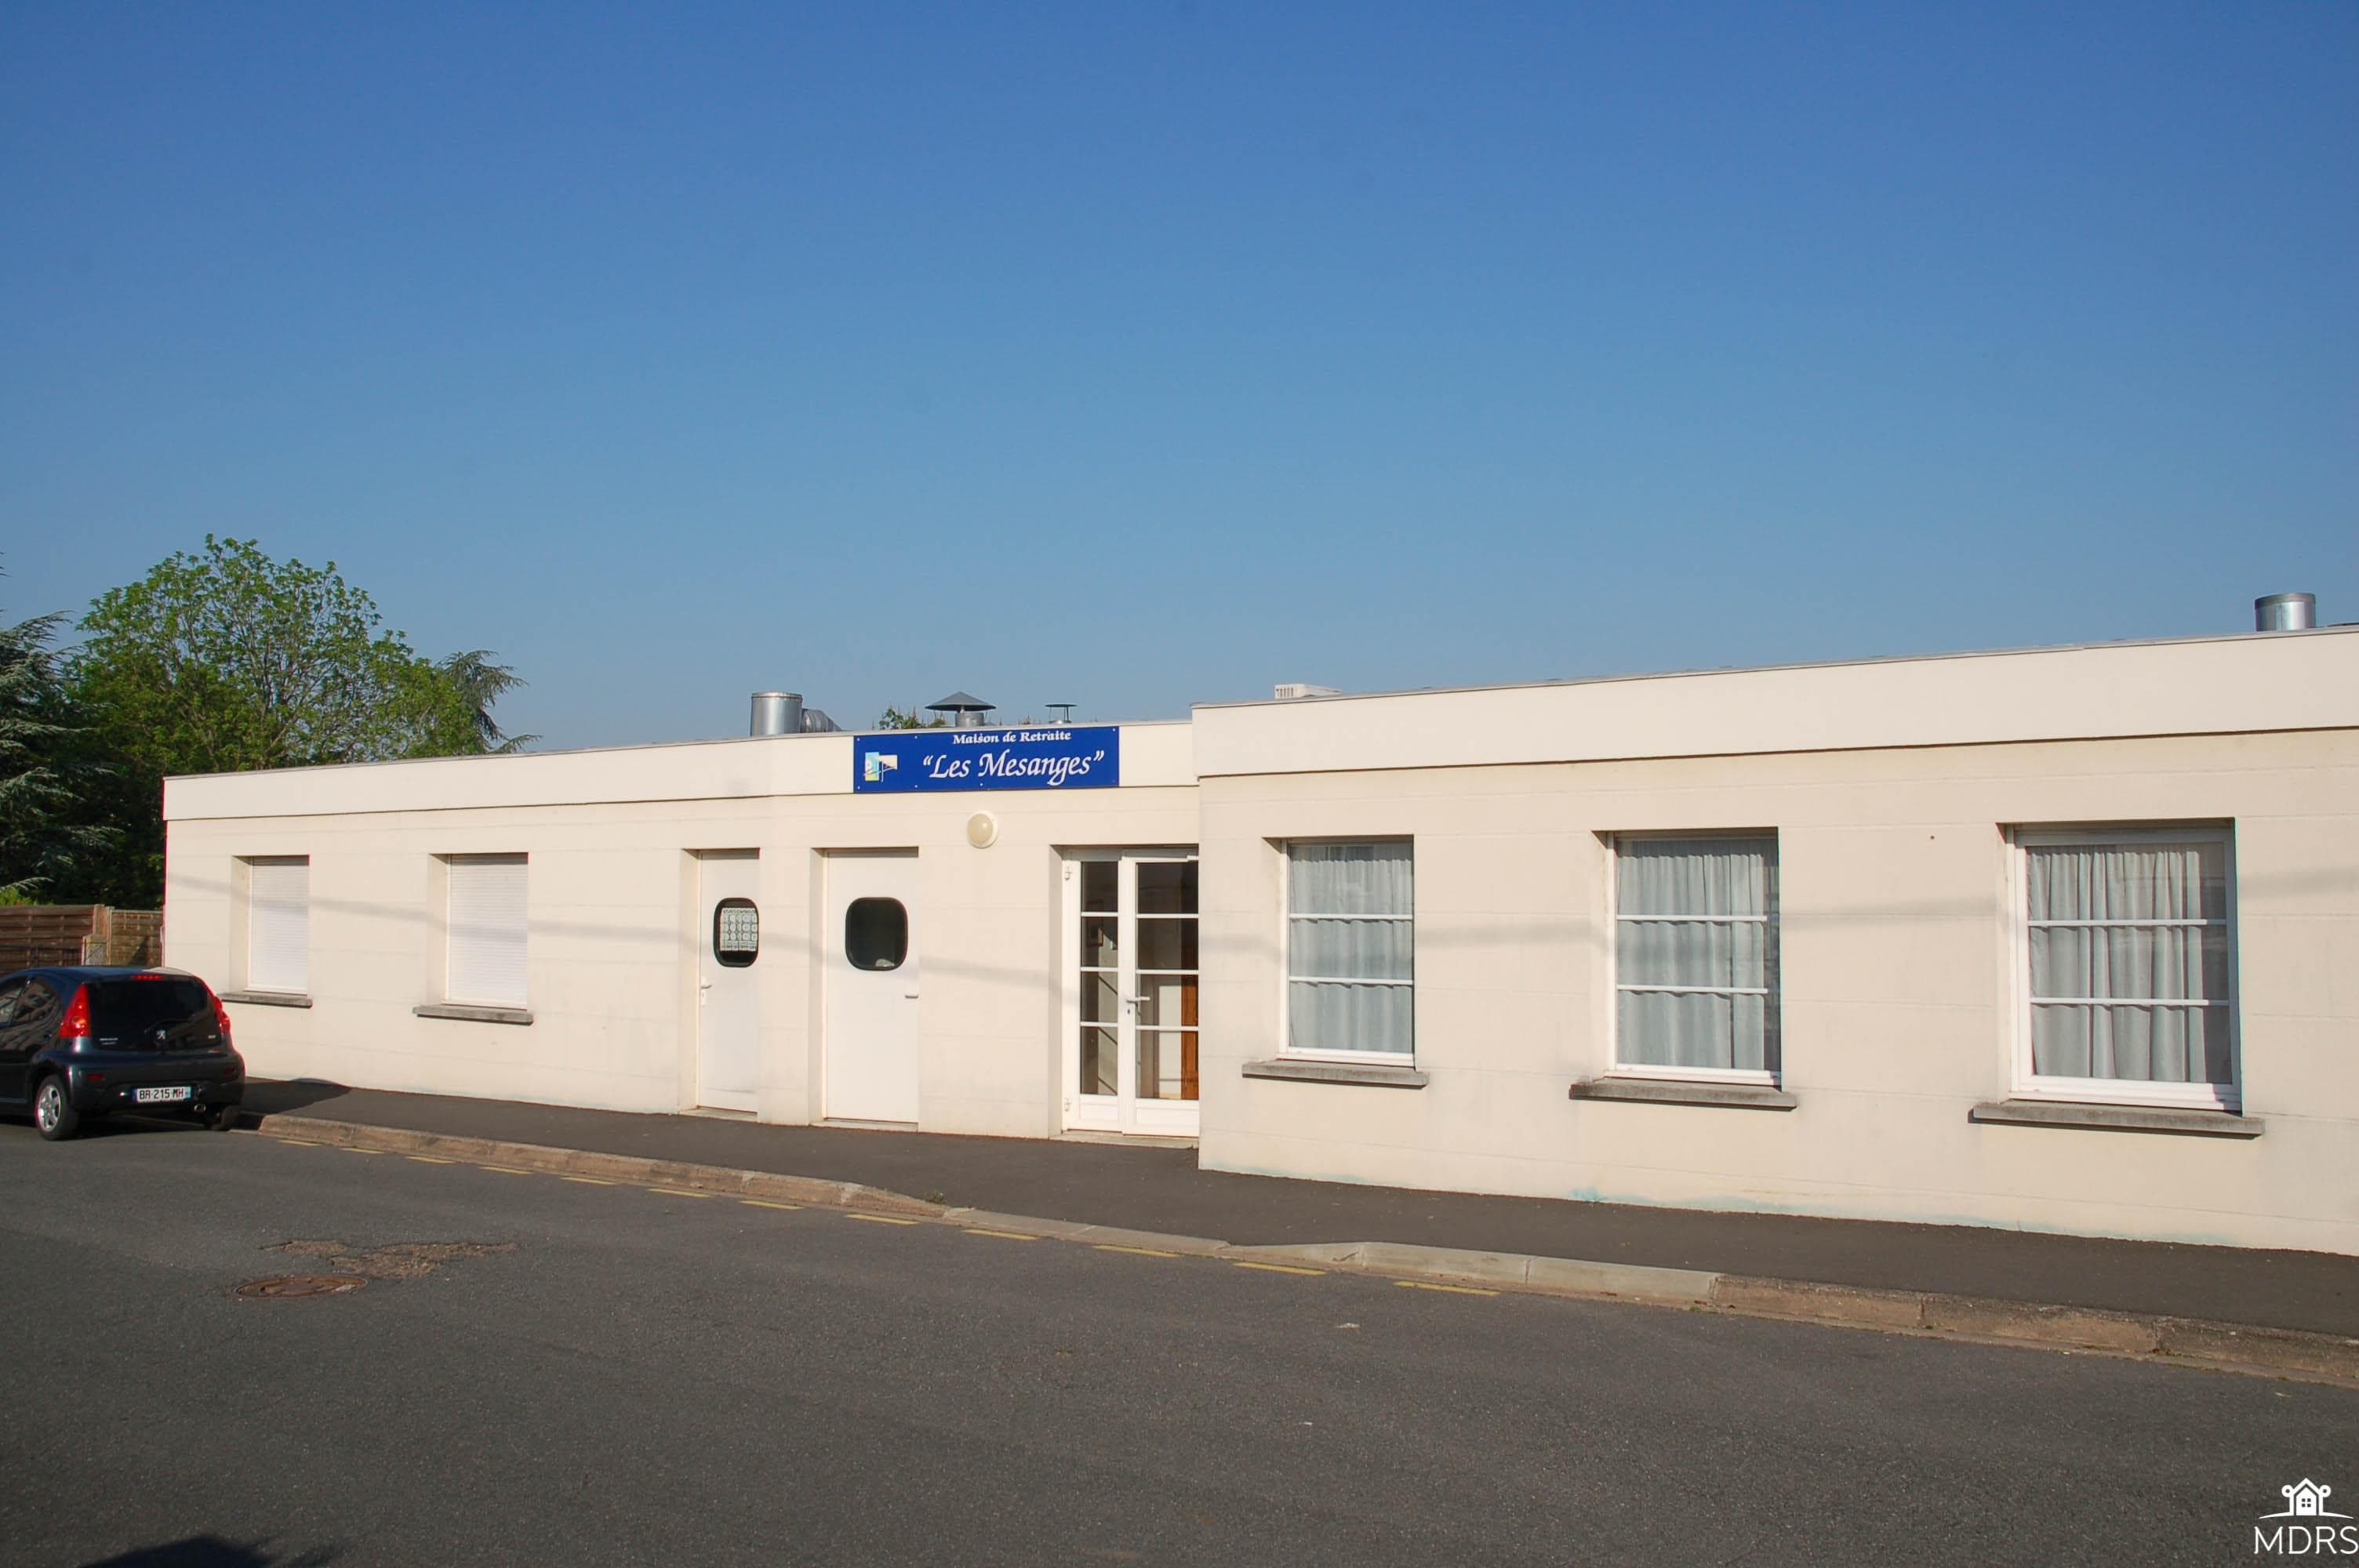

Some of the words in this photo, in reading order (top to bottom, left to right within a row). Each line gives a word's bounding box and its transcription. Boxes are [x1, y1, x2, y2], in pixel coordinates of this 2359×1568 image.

[952, 734, 1000, 745] Maison
[1002, 731, 1017, 742] de
[1019, 731, 1072, 742] Retraite
